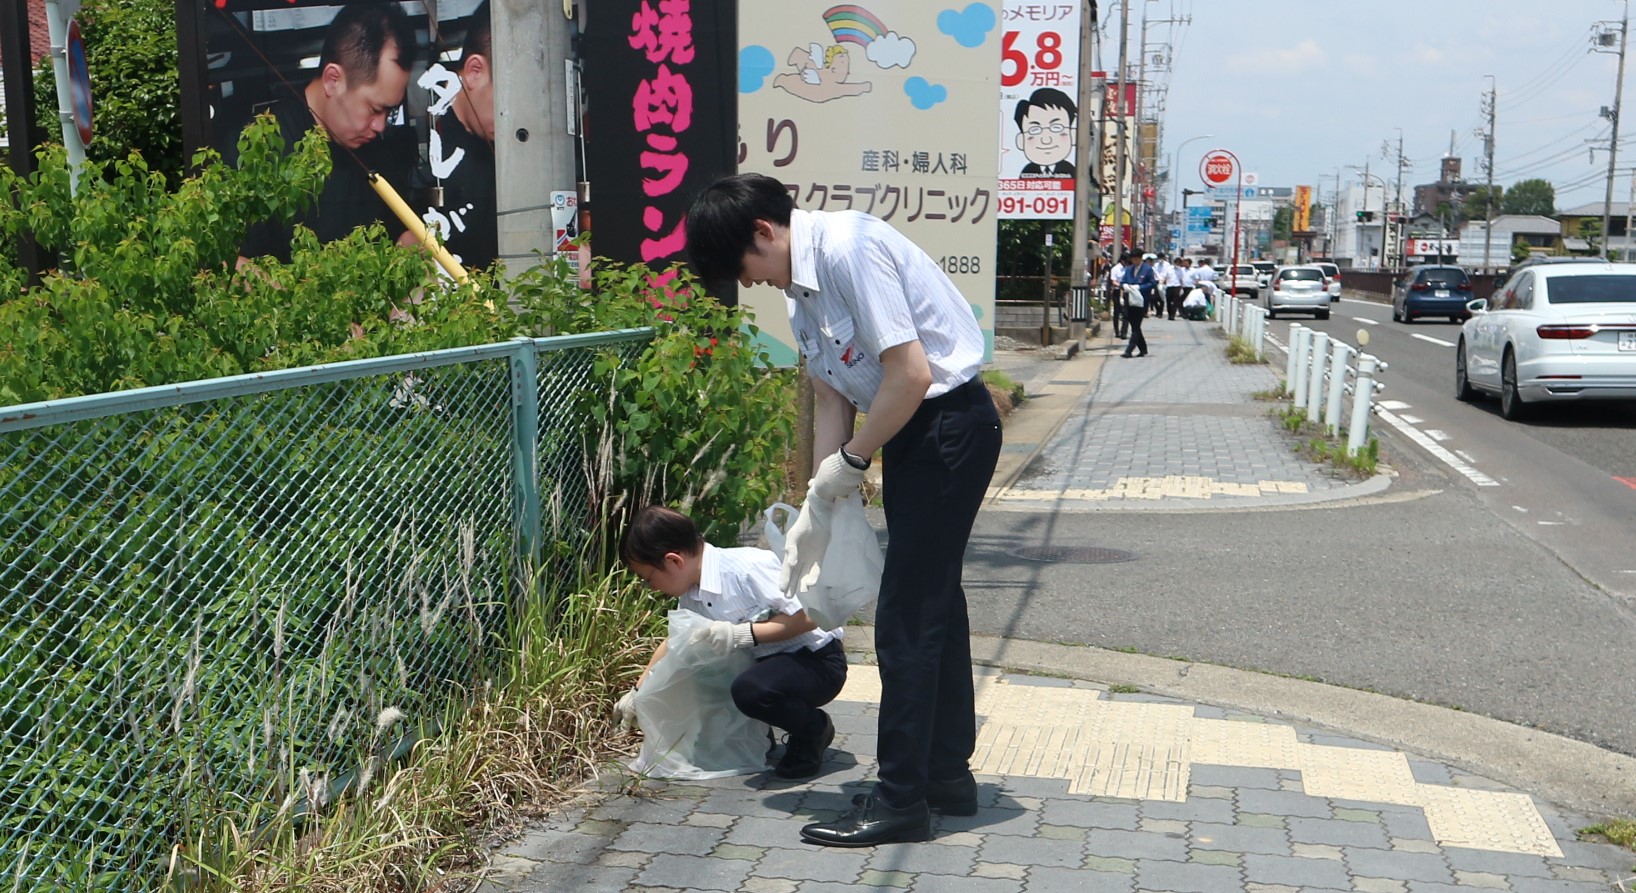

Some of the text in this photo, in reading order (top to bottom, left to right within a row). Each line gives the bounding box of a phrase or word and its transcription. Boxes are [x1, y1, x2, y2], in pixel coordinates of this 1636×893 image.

[861, 149, 967, 175] 産科・婦人科
